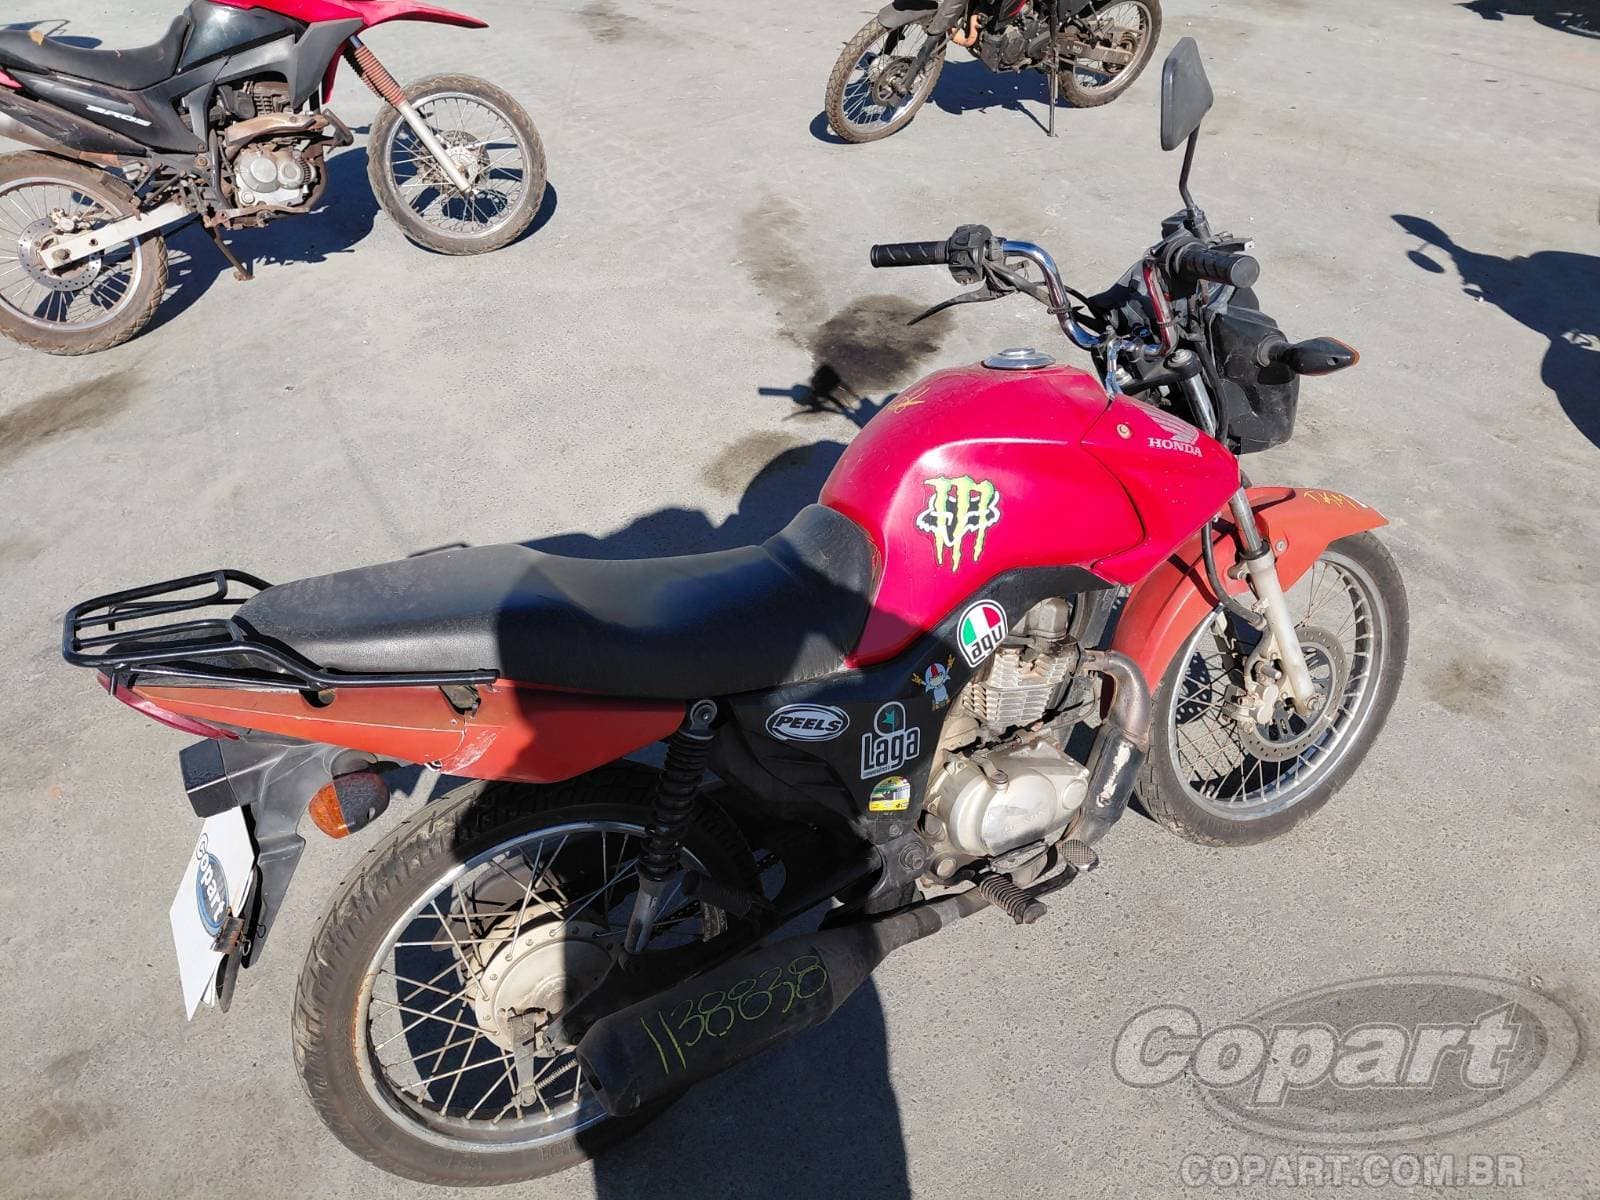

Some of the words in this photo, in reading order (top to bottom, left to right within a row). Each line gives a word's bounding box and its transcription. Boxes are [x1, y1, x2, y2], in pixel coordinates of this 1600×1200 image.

[1148, 437, 1203, 458] HONDA
[775, 715, 842, 732] PEELS
[863, 728, 920, 771] Laga
[195, 832, 226, 923] Copart
[639, 955, 828, 1075] 1138838
